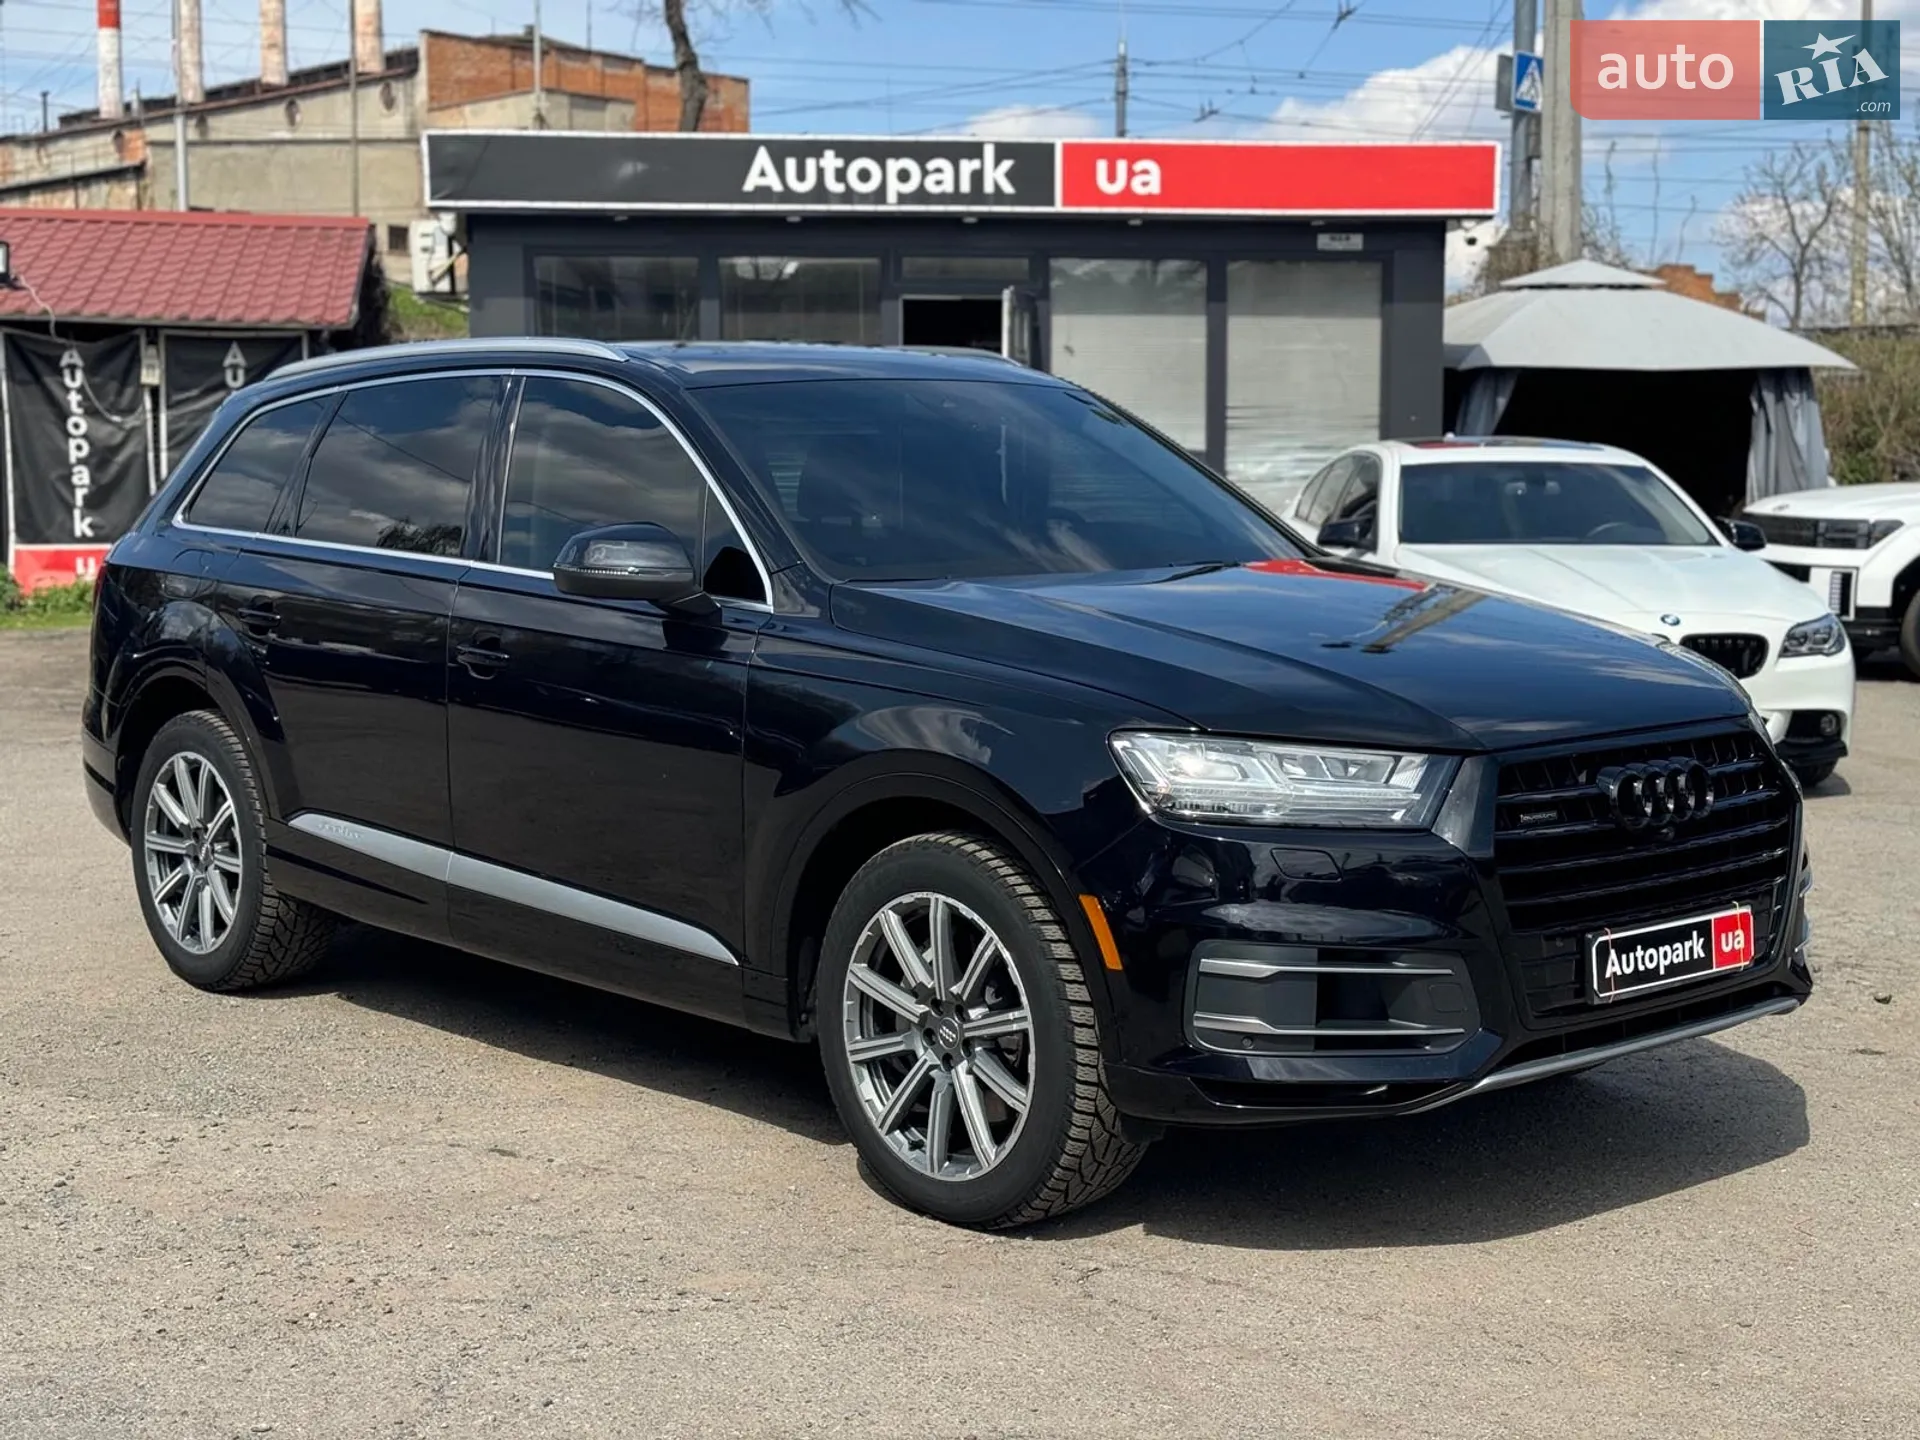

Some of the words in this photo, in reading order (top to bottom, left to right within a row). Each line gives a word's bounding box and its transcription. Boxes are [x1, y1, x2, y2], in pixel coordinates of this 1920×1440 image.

[742, 143, 1016, 204] Autopark
[1096, 158, 1161, 195] ua
[59, 349, 95, 538] Autopark
[1605, 930, 1706, 979] Autopark
[1720, 928, 1745, 953] ua
